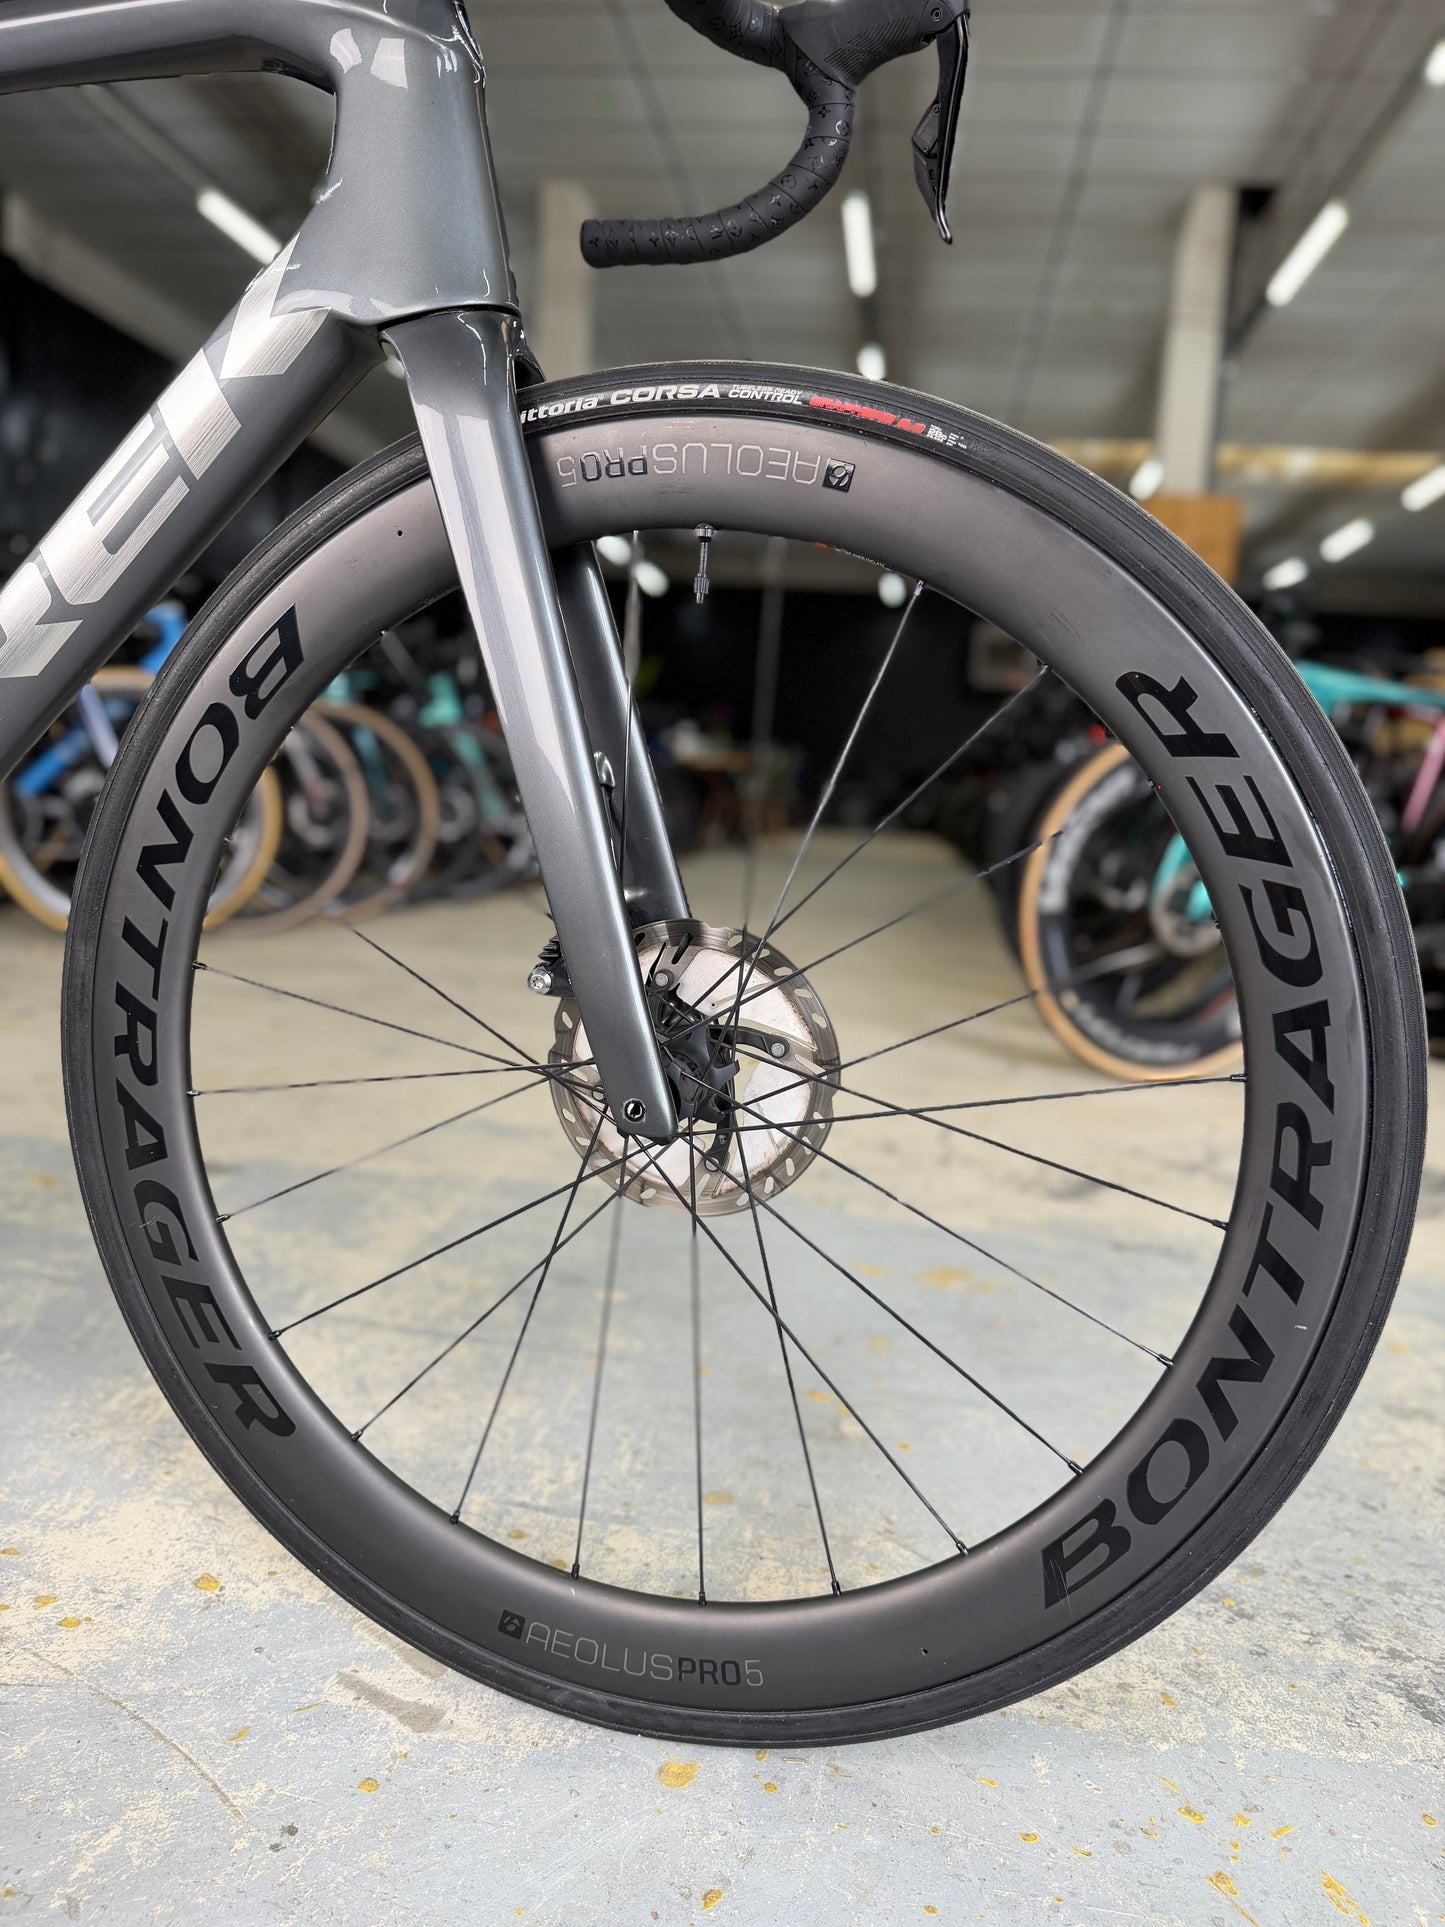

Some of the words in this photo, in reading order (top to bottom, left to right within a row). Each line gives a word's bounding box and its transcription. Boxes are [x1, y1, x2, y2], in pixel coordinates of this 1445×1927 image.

[610, 383, 721, 405] CORSA
[728, 389, 803, 405] CONTROL
[114, 603, 305, 1437] BONTRAGER
[1042, 671, 1335, 1610] BONTRAGER
